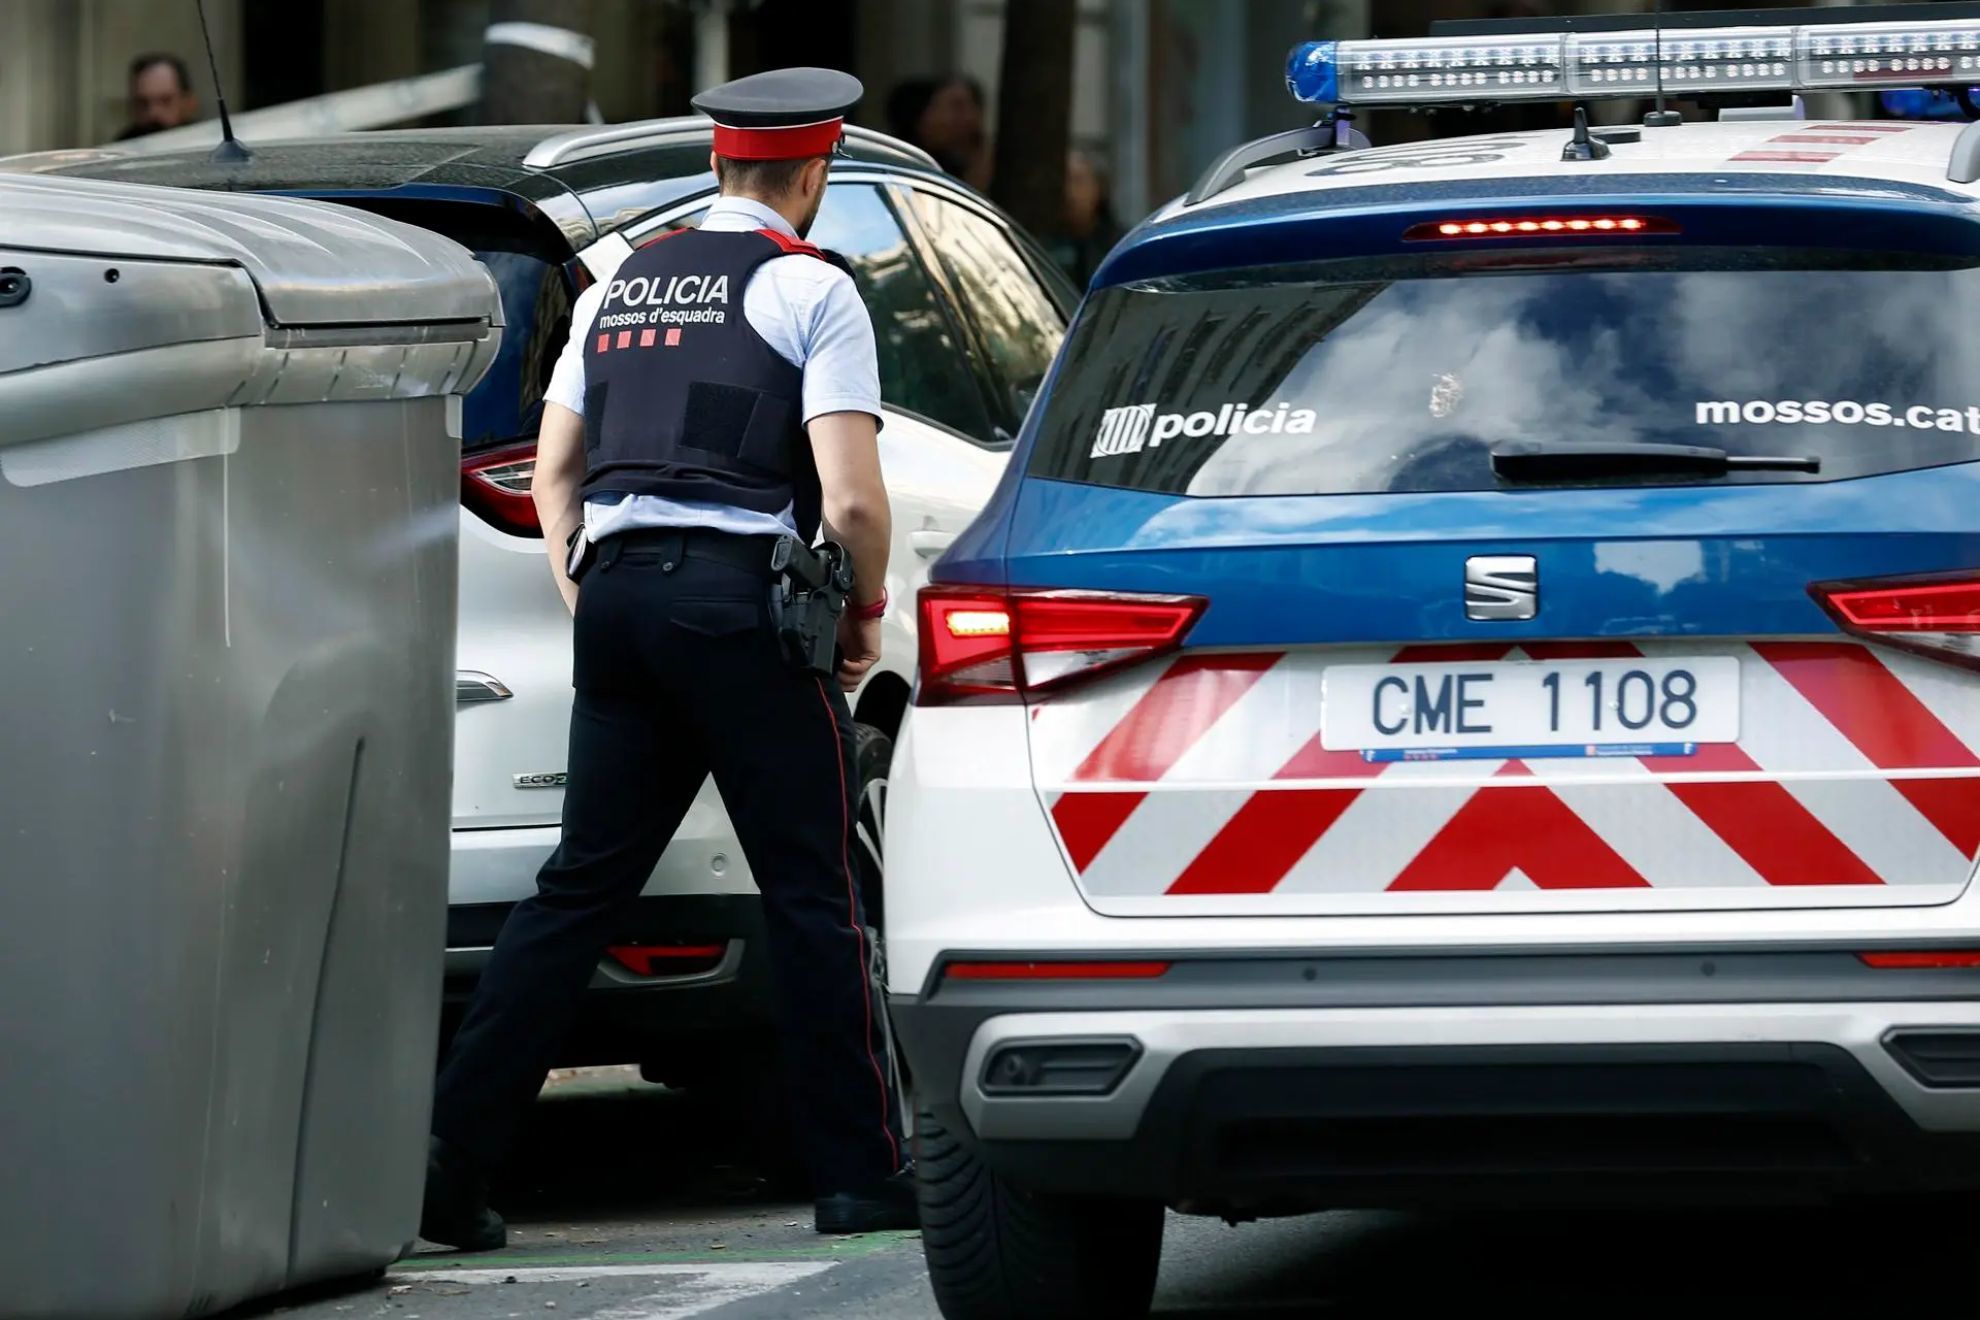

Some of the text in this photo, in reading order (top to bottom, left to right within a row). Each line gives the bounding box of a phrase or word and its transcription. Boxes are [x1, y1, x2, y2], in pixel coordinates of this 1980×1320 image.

[603, 275, 728, 309] POLICIA
[600, 307, 725, 328] mossos d'esquadra
[1148, 402, 1317, 447] policia
[1695, 400, 1980, 435] mossos.cat
[1372, 670, 1697, 736] CME 1108
